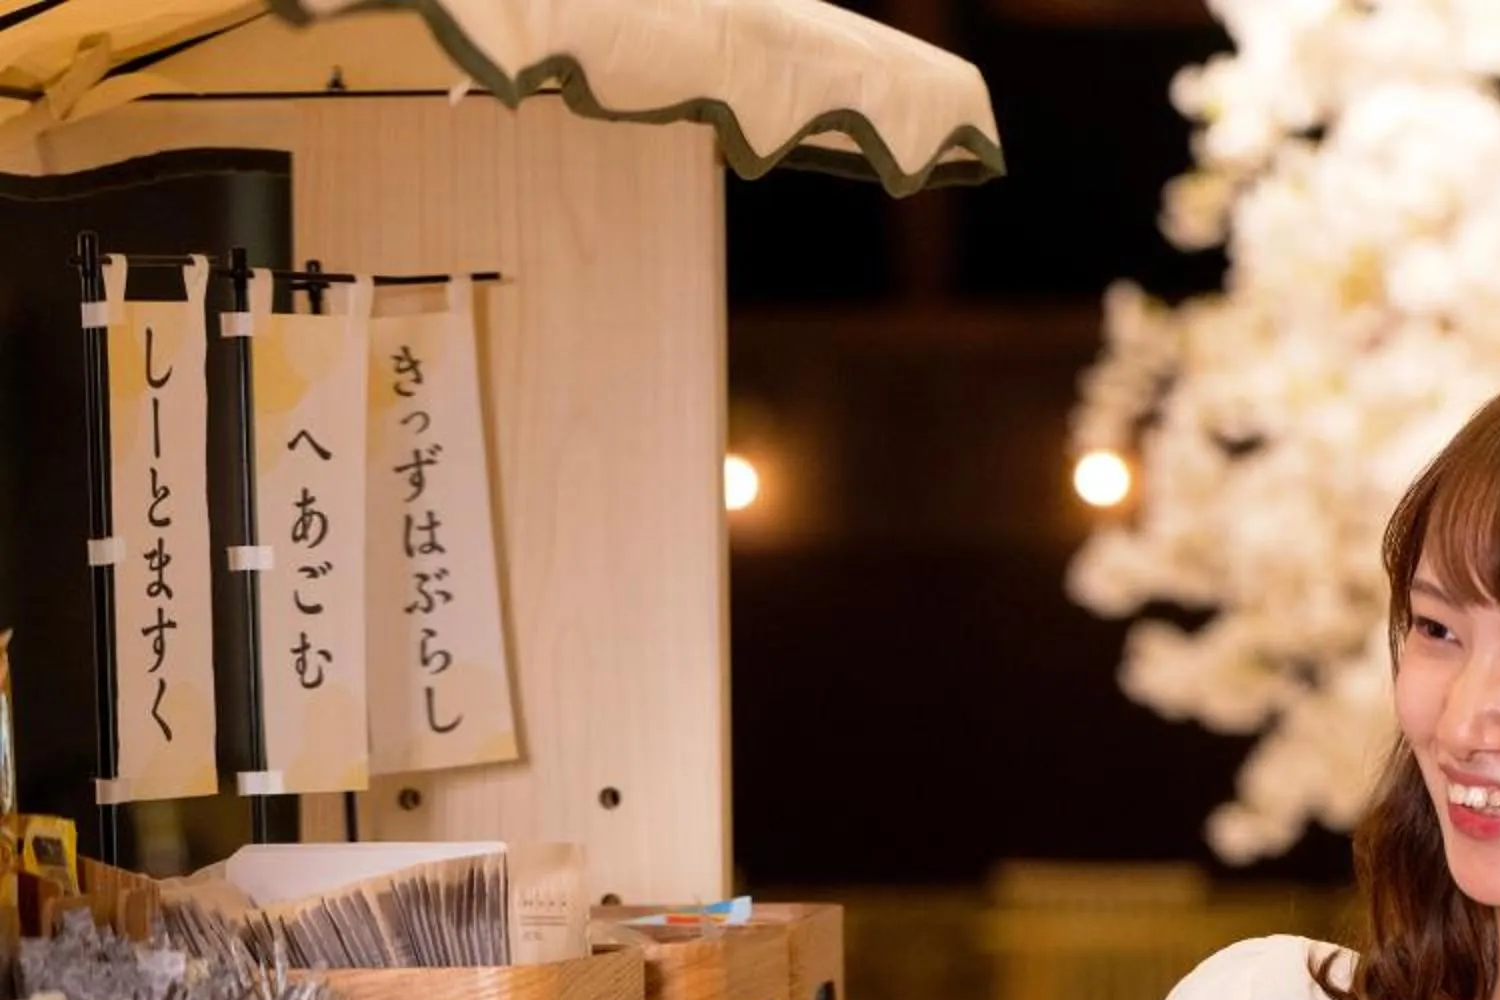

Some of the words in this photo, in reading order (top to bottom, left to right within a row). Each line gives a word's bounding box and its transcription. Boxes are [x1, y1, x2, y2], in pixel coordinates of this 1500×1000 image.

[140, 326, 178, 743] しーとますく
[287, 428, 334, 690] へあごむ
[391, 345, 464, 734] きっずはぶらし
